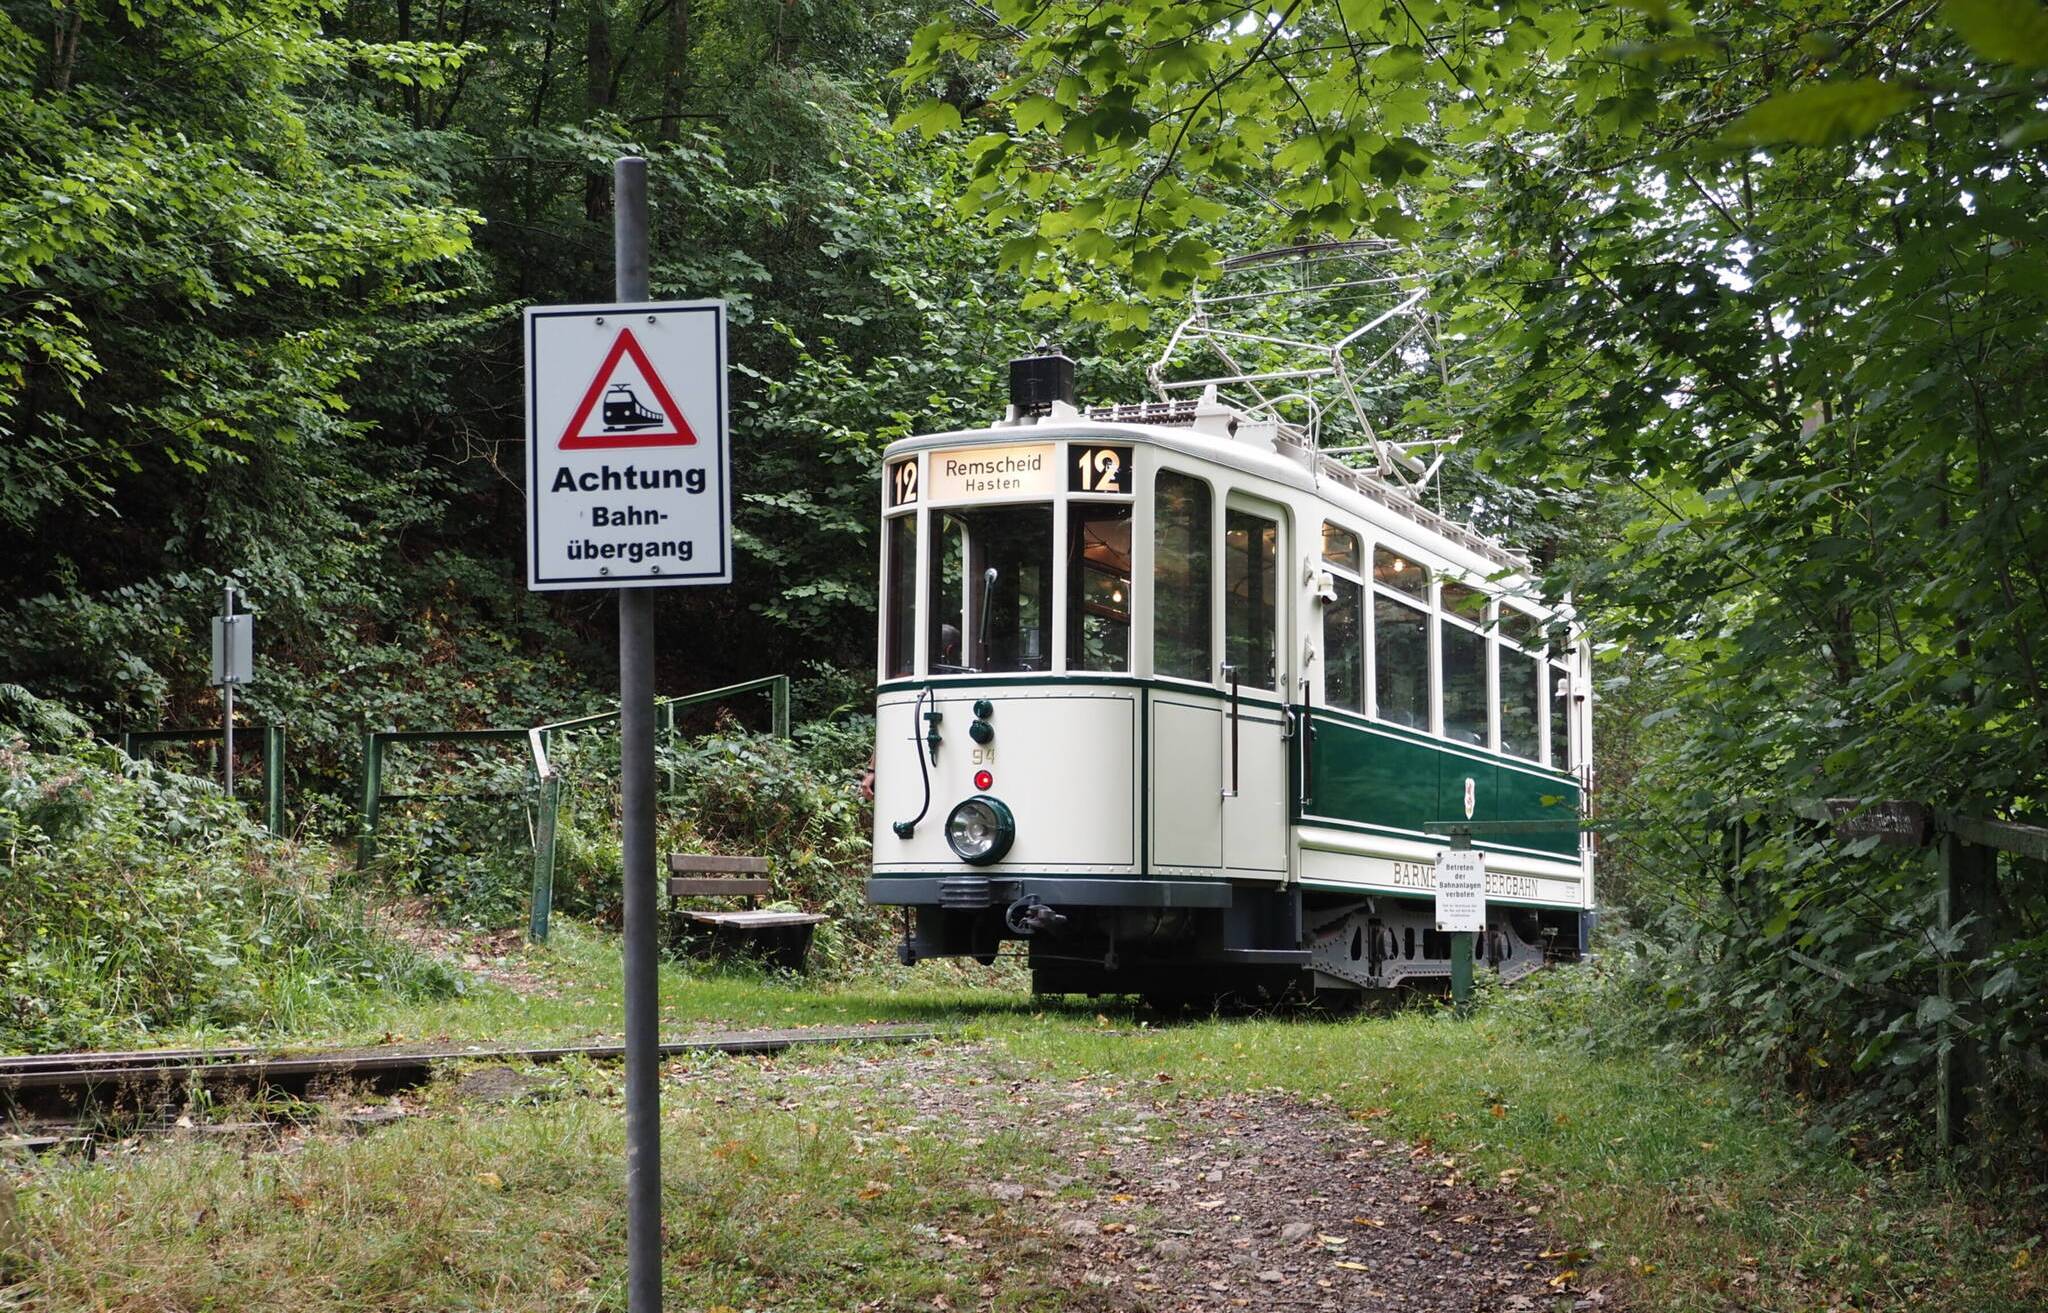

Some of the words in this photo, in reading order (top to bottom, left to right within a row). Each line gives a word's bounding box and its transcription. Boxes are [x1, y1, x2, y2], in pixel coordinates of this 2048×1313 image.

[945, 454, 1041, 477] Remscheid
[1078, 448, 1121, 493] 12
[551, 464, 707, 495] Achtung
[894, 461, 918, 506] 12
[965, 477, 1021, 492] Hasten
[591, 505, 668, 527] Bahn-
[566, 539, 693, 563] übergang
[972, 748, 995, 765] 94
[1445, 863, 1474, 871] Betreten
[1393, 862, 1437, 888] BARME
[1485, 873, 1539, 897] BERGBAHN
[1439, 882, 1482, 891] Bahnanlagen
